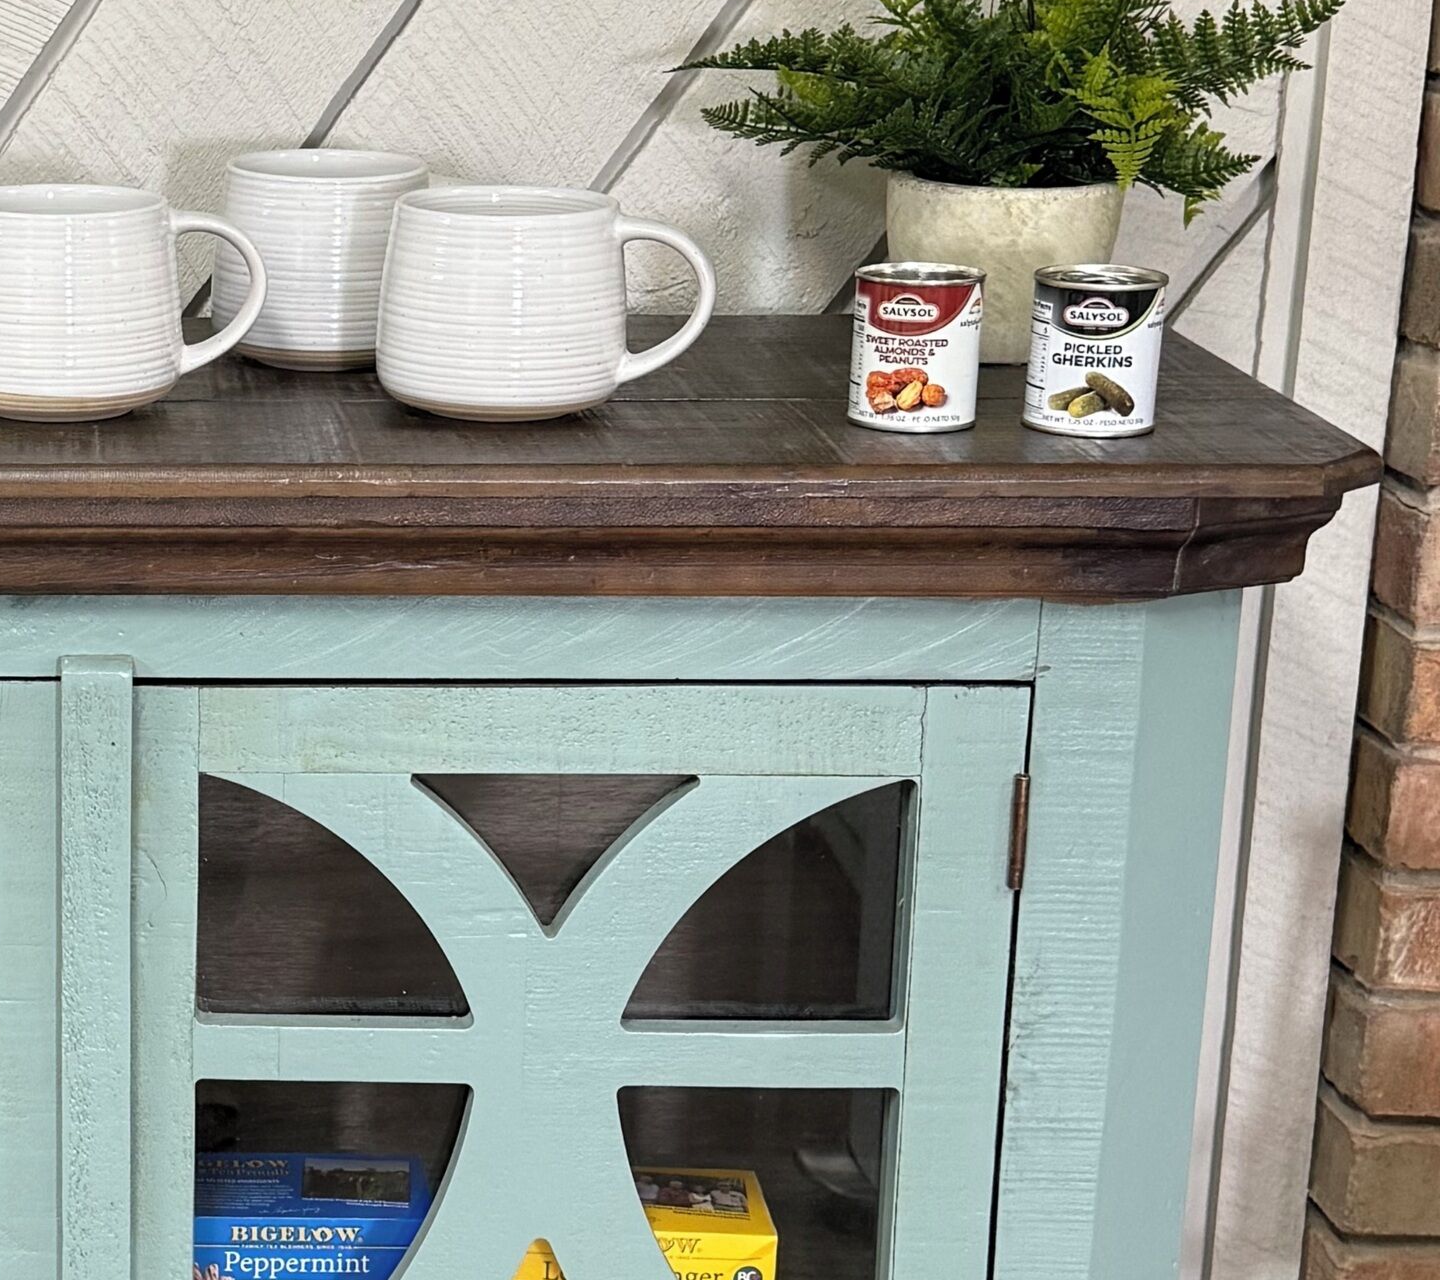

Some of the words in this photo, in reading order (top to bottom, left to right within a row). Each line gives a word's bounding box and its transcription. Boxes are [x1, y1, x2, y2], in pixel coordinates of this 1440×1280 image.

[882, 306, 934, 318] SALYSOL
[1070, 310, 1123, 322] SALYSOL
[866, 334, 897, 346] SWEET
[898, 338, 949, 348] ROASTED
[874, 345, 926, 357] ALMONDS
[1064, 342, 1123, 356] PICKLED
[879, 354, 929, 366] PEANUTS
[1052, 353, 1133, 368] GHERKINS
[231, 1225, 361, 1243] BIGELOW
[223, 1250, 371, 1279] Peppermint
